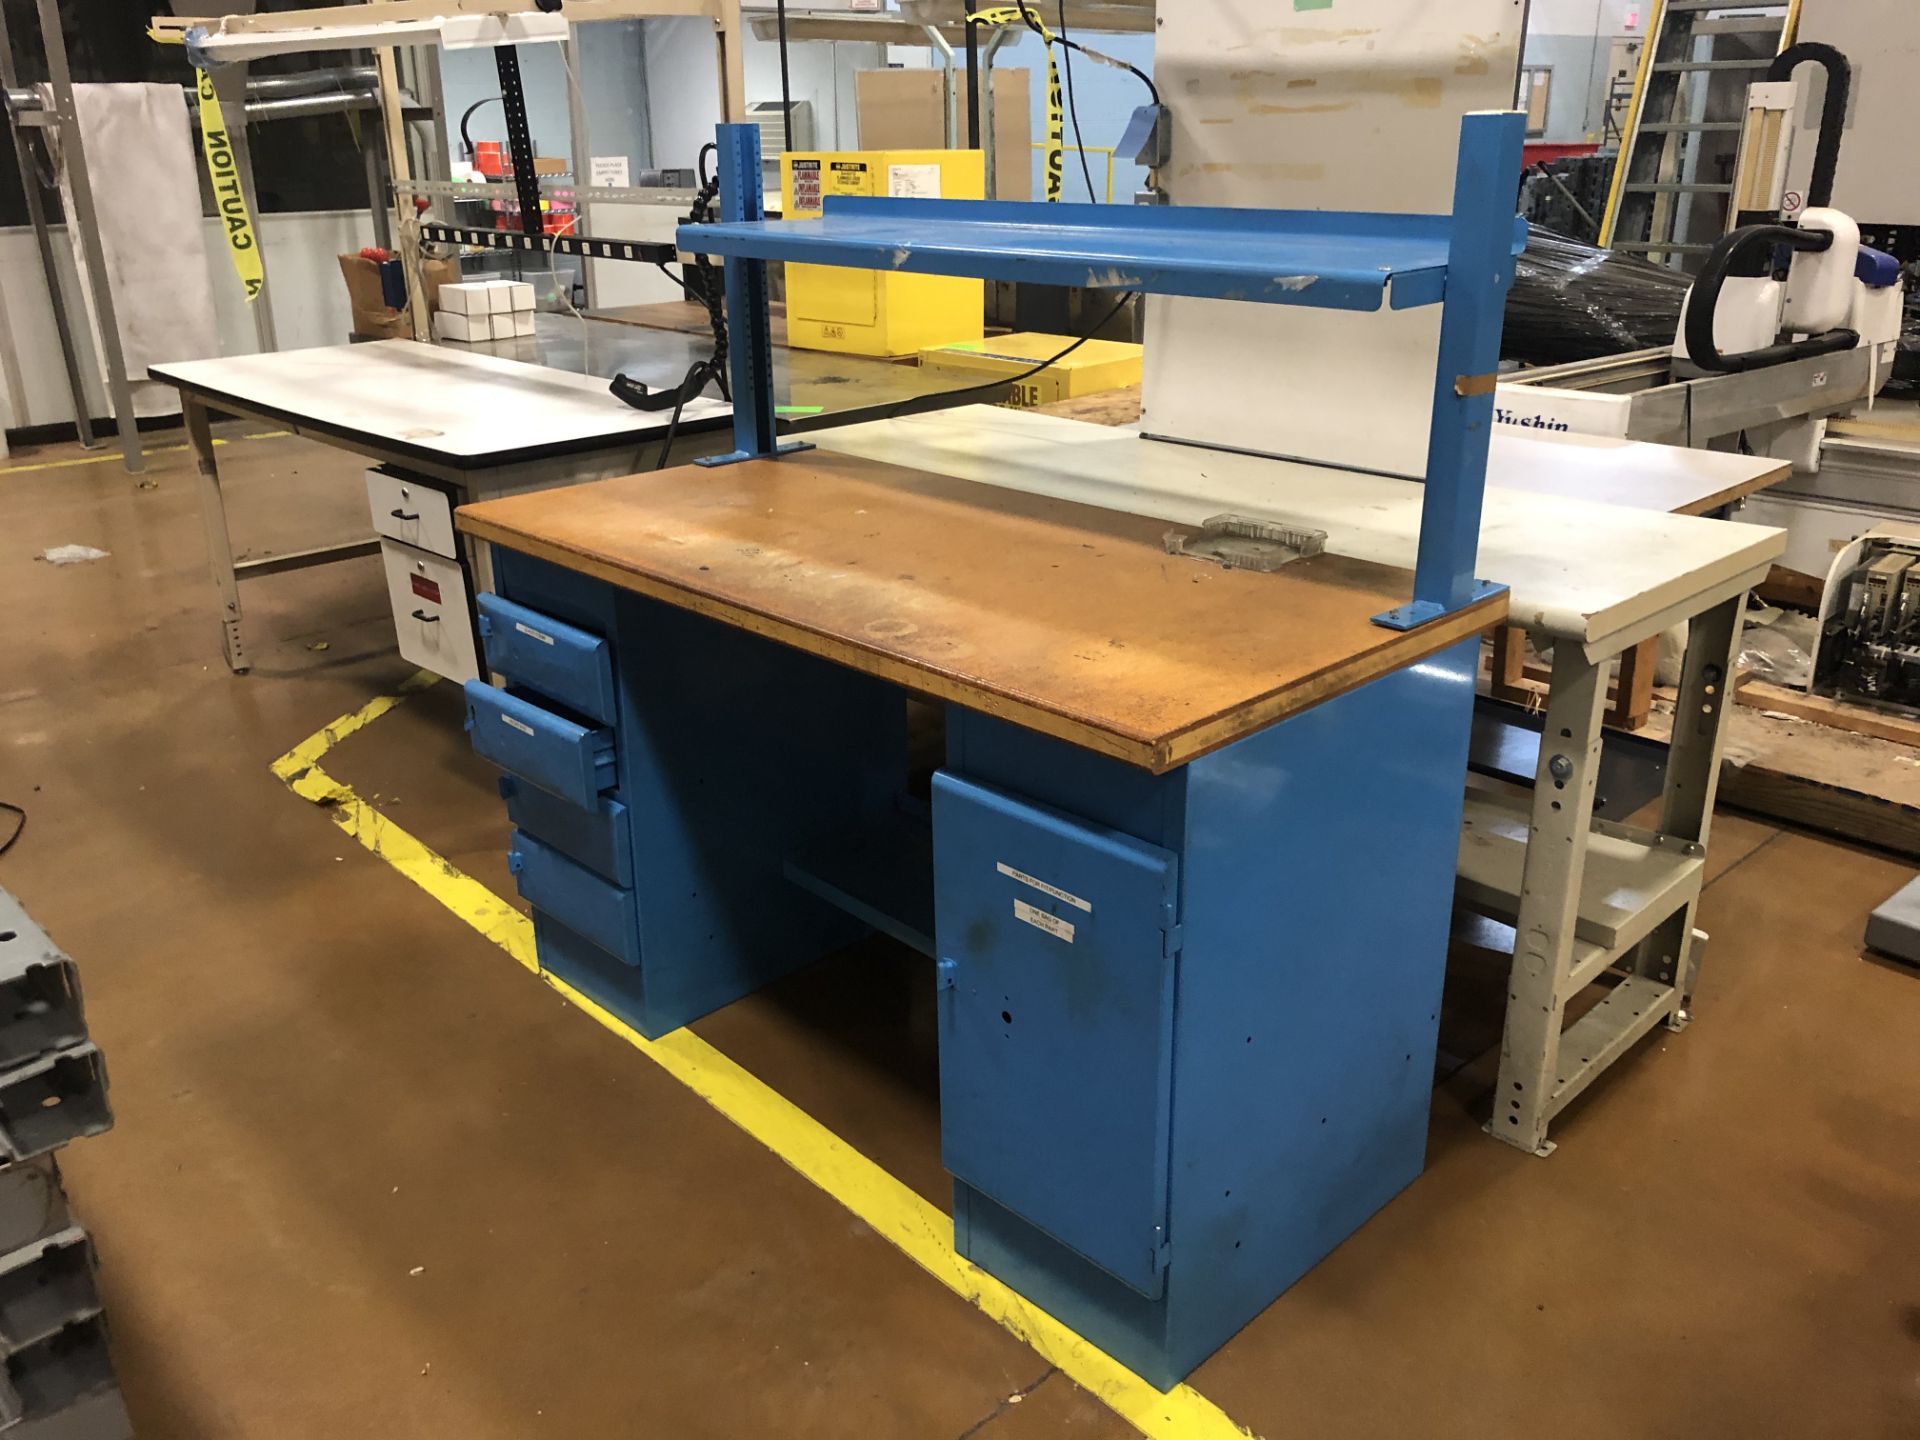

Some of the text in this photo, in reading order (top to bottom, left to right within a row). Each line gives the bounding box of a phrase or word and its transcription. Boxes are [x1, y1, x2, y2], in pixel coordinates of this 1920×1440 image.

[1496, 409, 1568, 432] Yushin
[1012, 871, 1028, 882] PARTS
[1029, 877, 1041, 888] FOR
[1029, 907, 1040, 916] ONE
[1041, 912, 1052, 922] BAG
[1030, 917, 1058, 934] EACH PART
